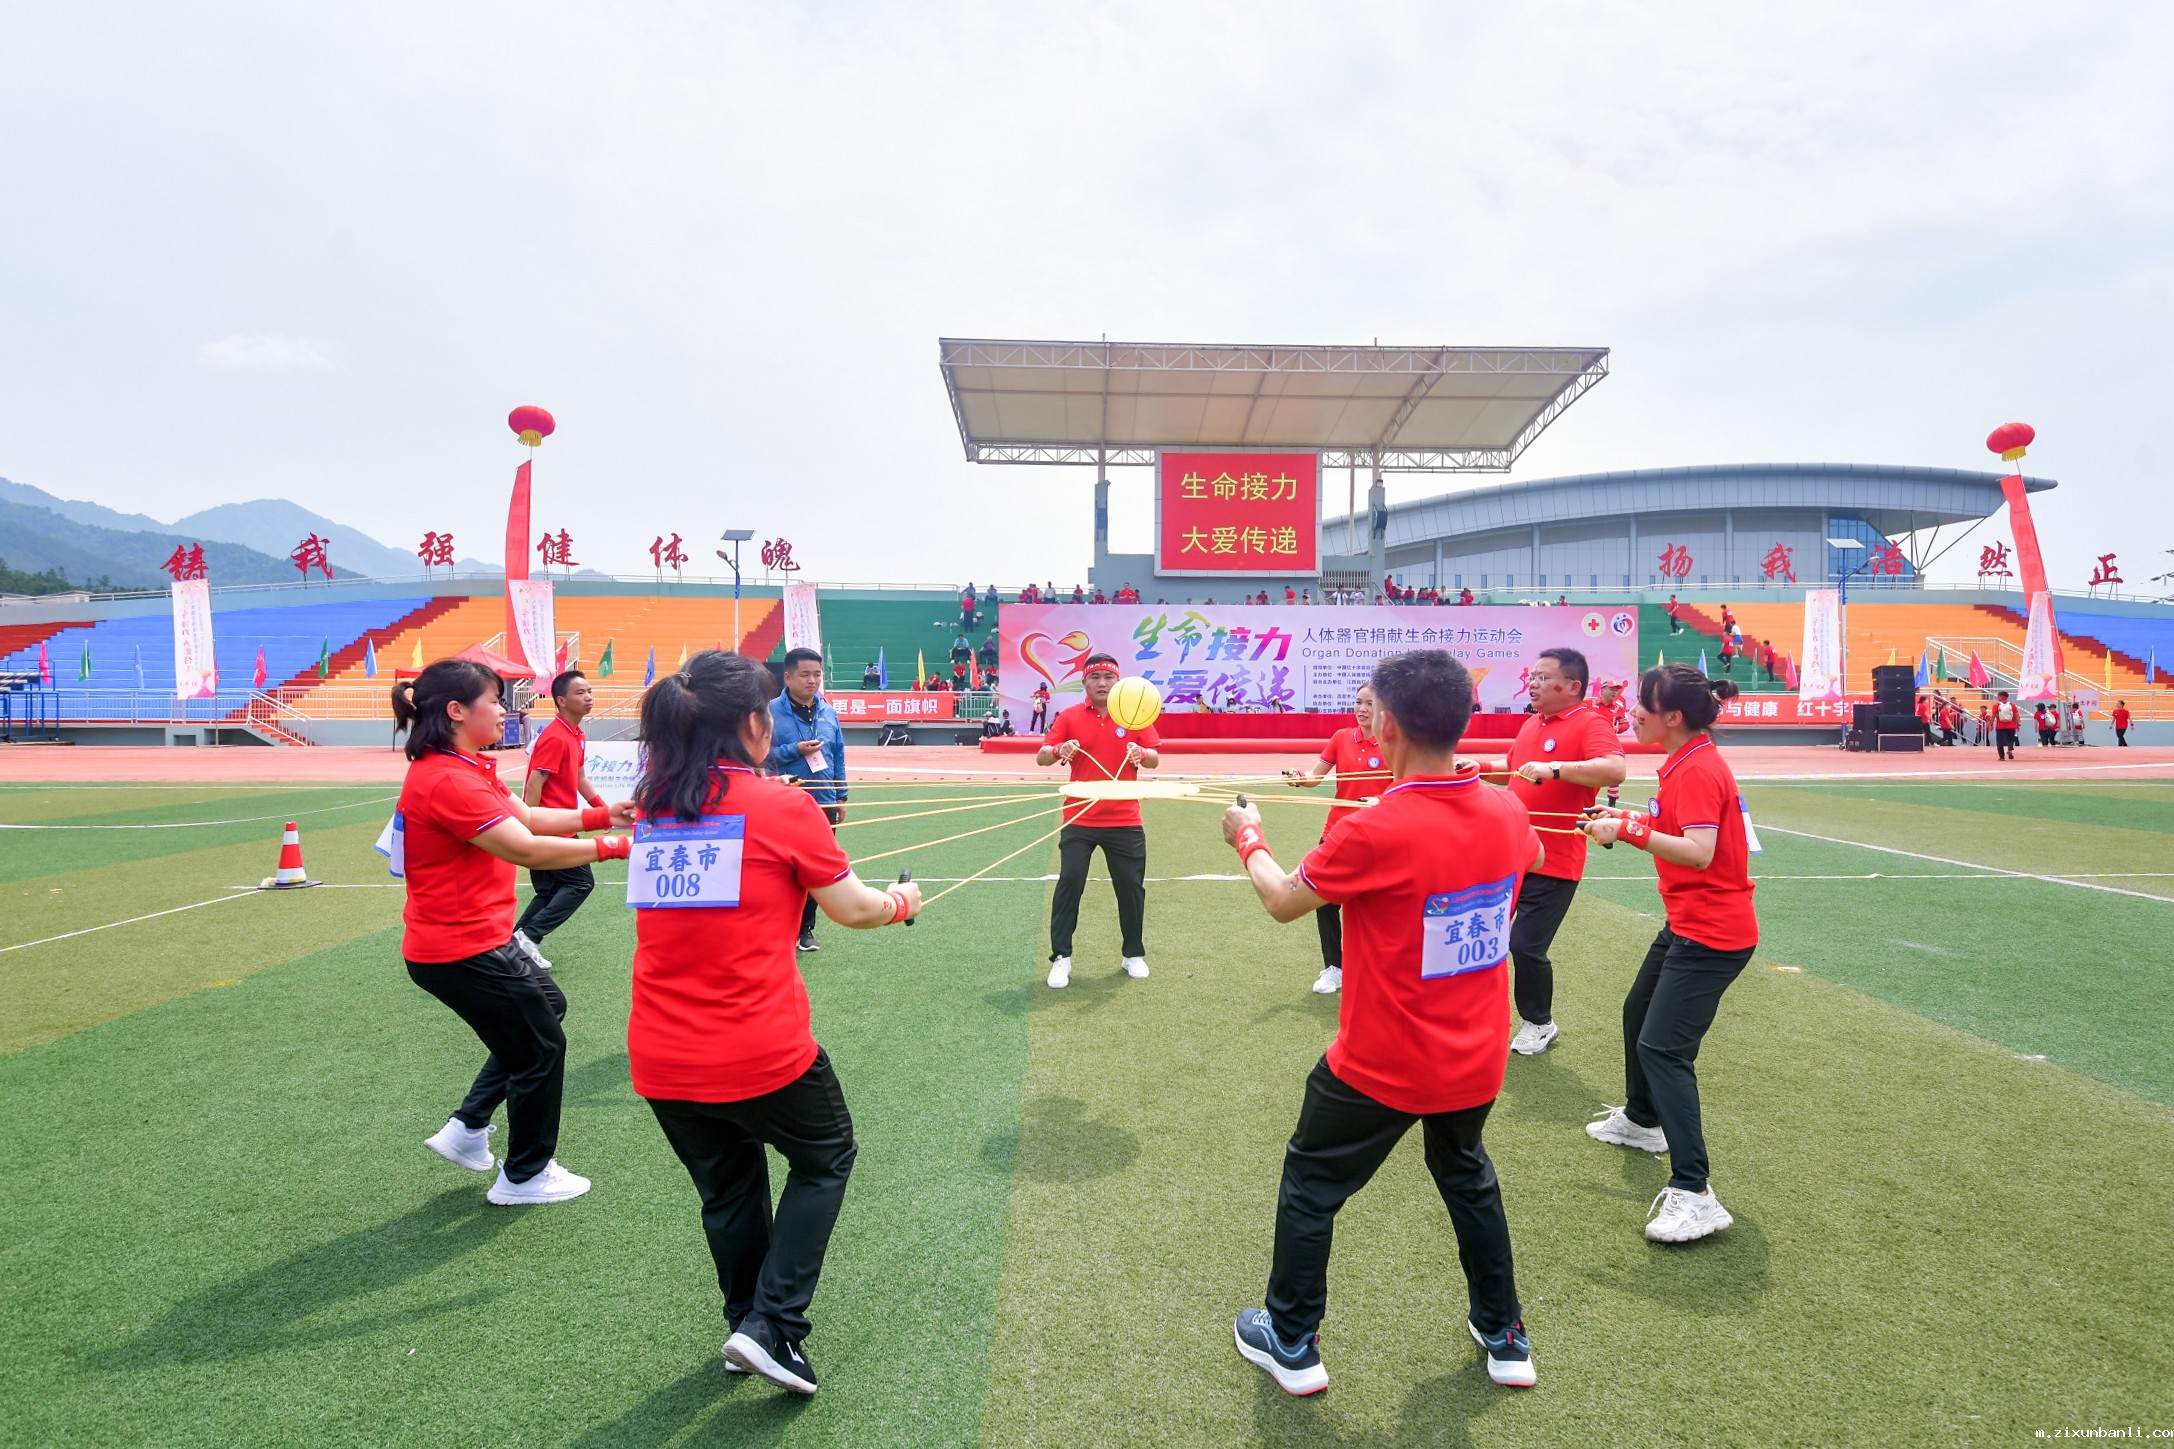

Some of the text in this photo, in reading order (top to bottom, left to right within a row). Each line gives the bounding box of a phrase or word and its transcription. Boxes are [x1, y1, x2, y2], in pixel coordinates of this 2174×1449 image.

[1180, 471, 1298, 501] 生命接力
[1180, 525, 1298, 555] 大爱传递
[1132, 611, 1293, 665] 生命接力
[1302, 627, 1523, 645] 人体器官捐献生命接力运动会
[1302, 647, 1340, 660] Organ
[1477, 647, 1520, 659] Games
[832, 698, 938, 715] 更是一面旗帜
[1718, 700, 1876, 718] 与健康 红十字
[586, 755, 633, 773] 命接力
[645, 844, 720, 872] 宜春市
[656, 873, 701, 898] 008
[1445, 907, 1506, 945] 宜春市
[1458, 937, 1499, 965] 003
